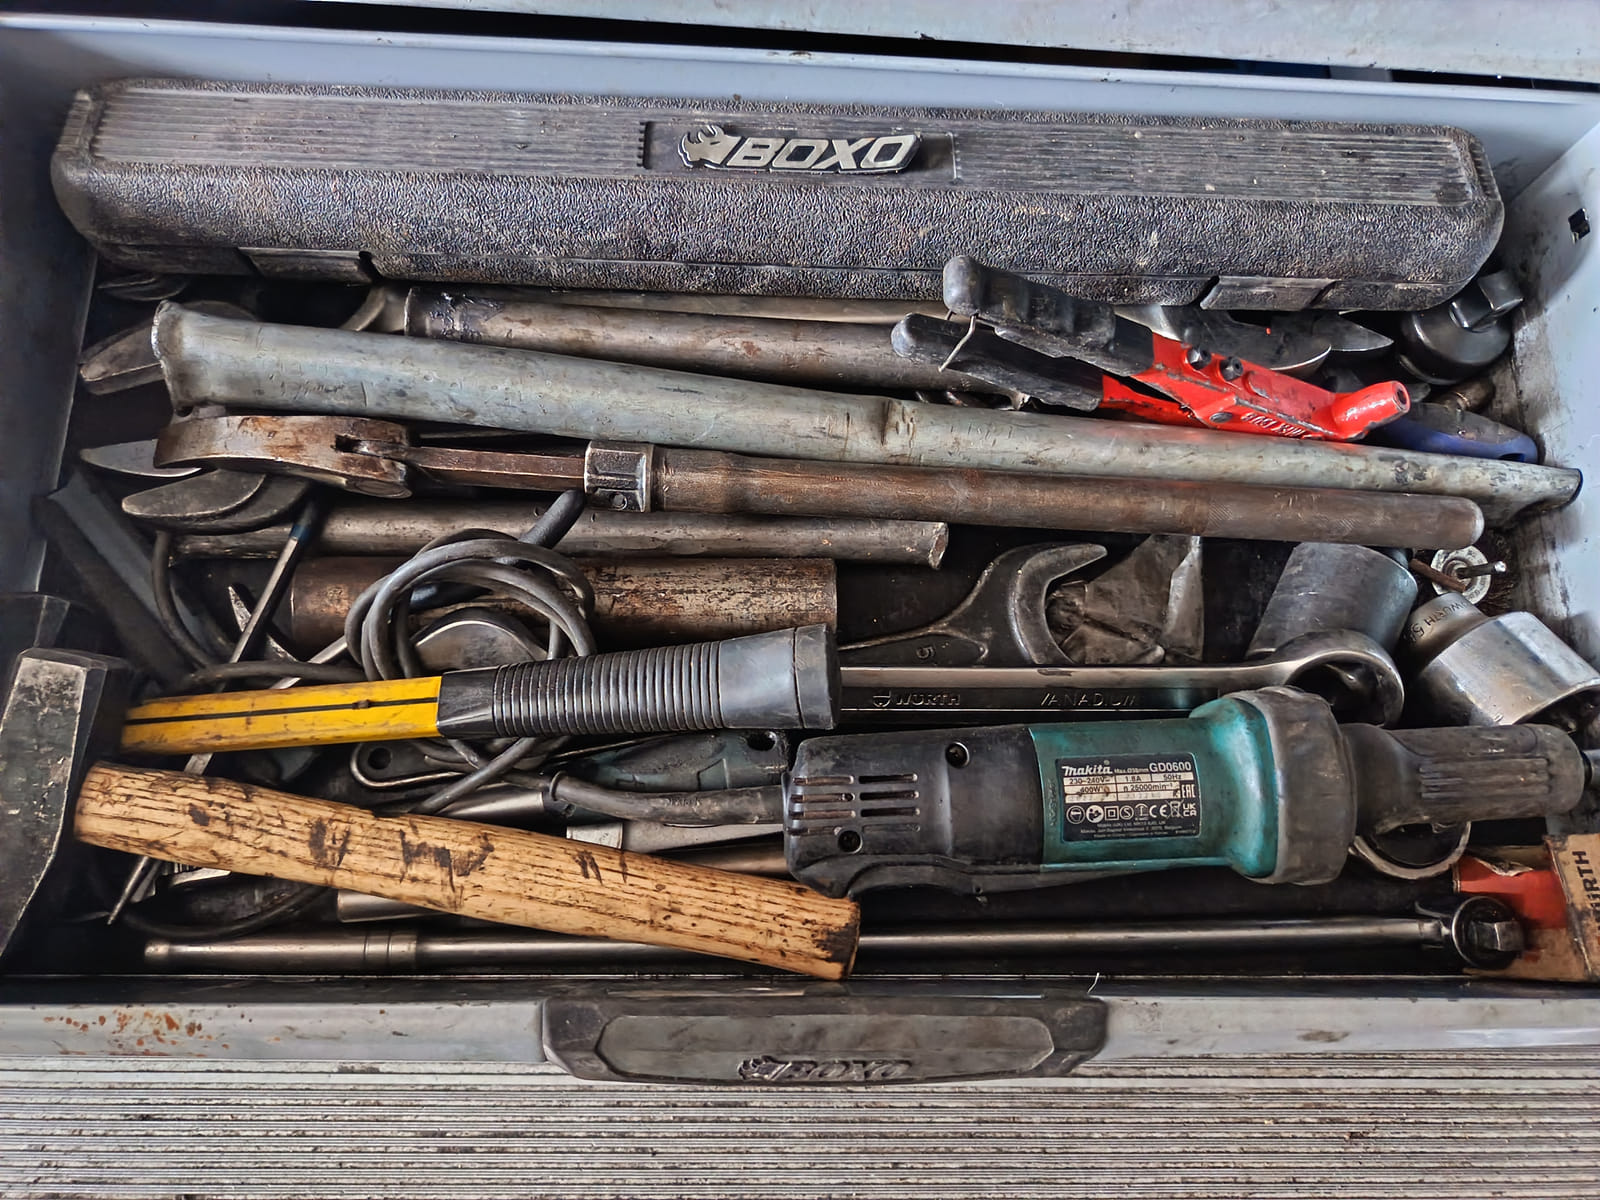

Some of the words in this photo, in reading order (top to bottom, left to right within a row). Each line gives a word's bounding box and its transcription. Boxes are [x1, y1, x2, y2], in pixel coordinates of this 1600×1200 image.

[726, 134, 917, 169] BOXO
[1149, 761, 1192, 773] GD0600
[1163, 773, 1182, 781] 50Hz
